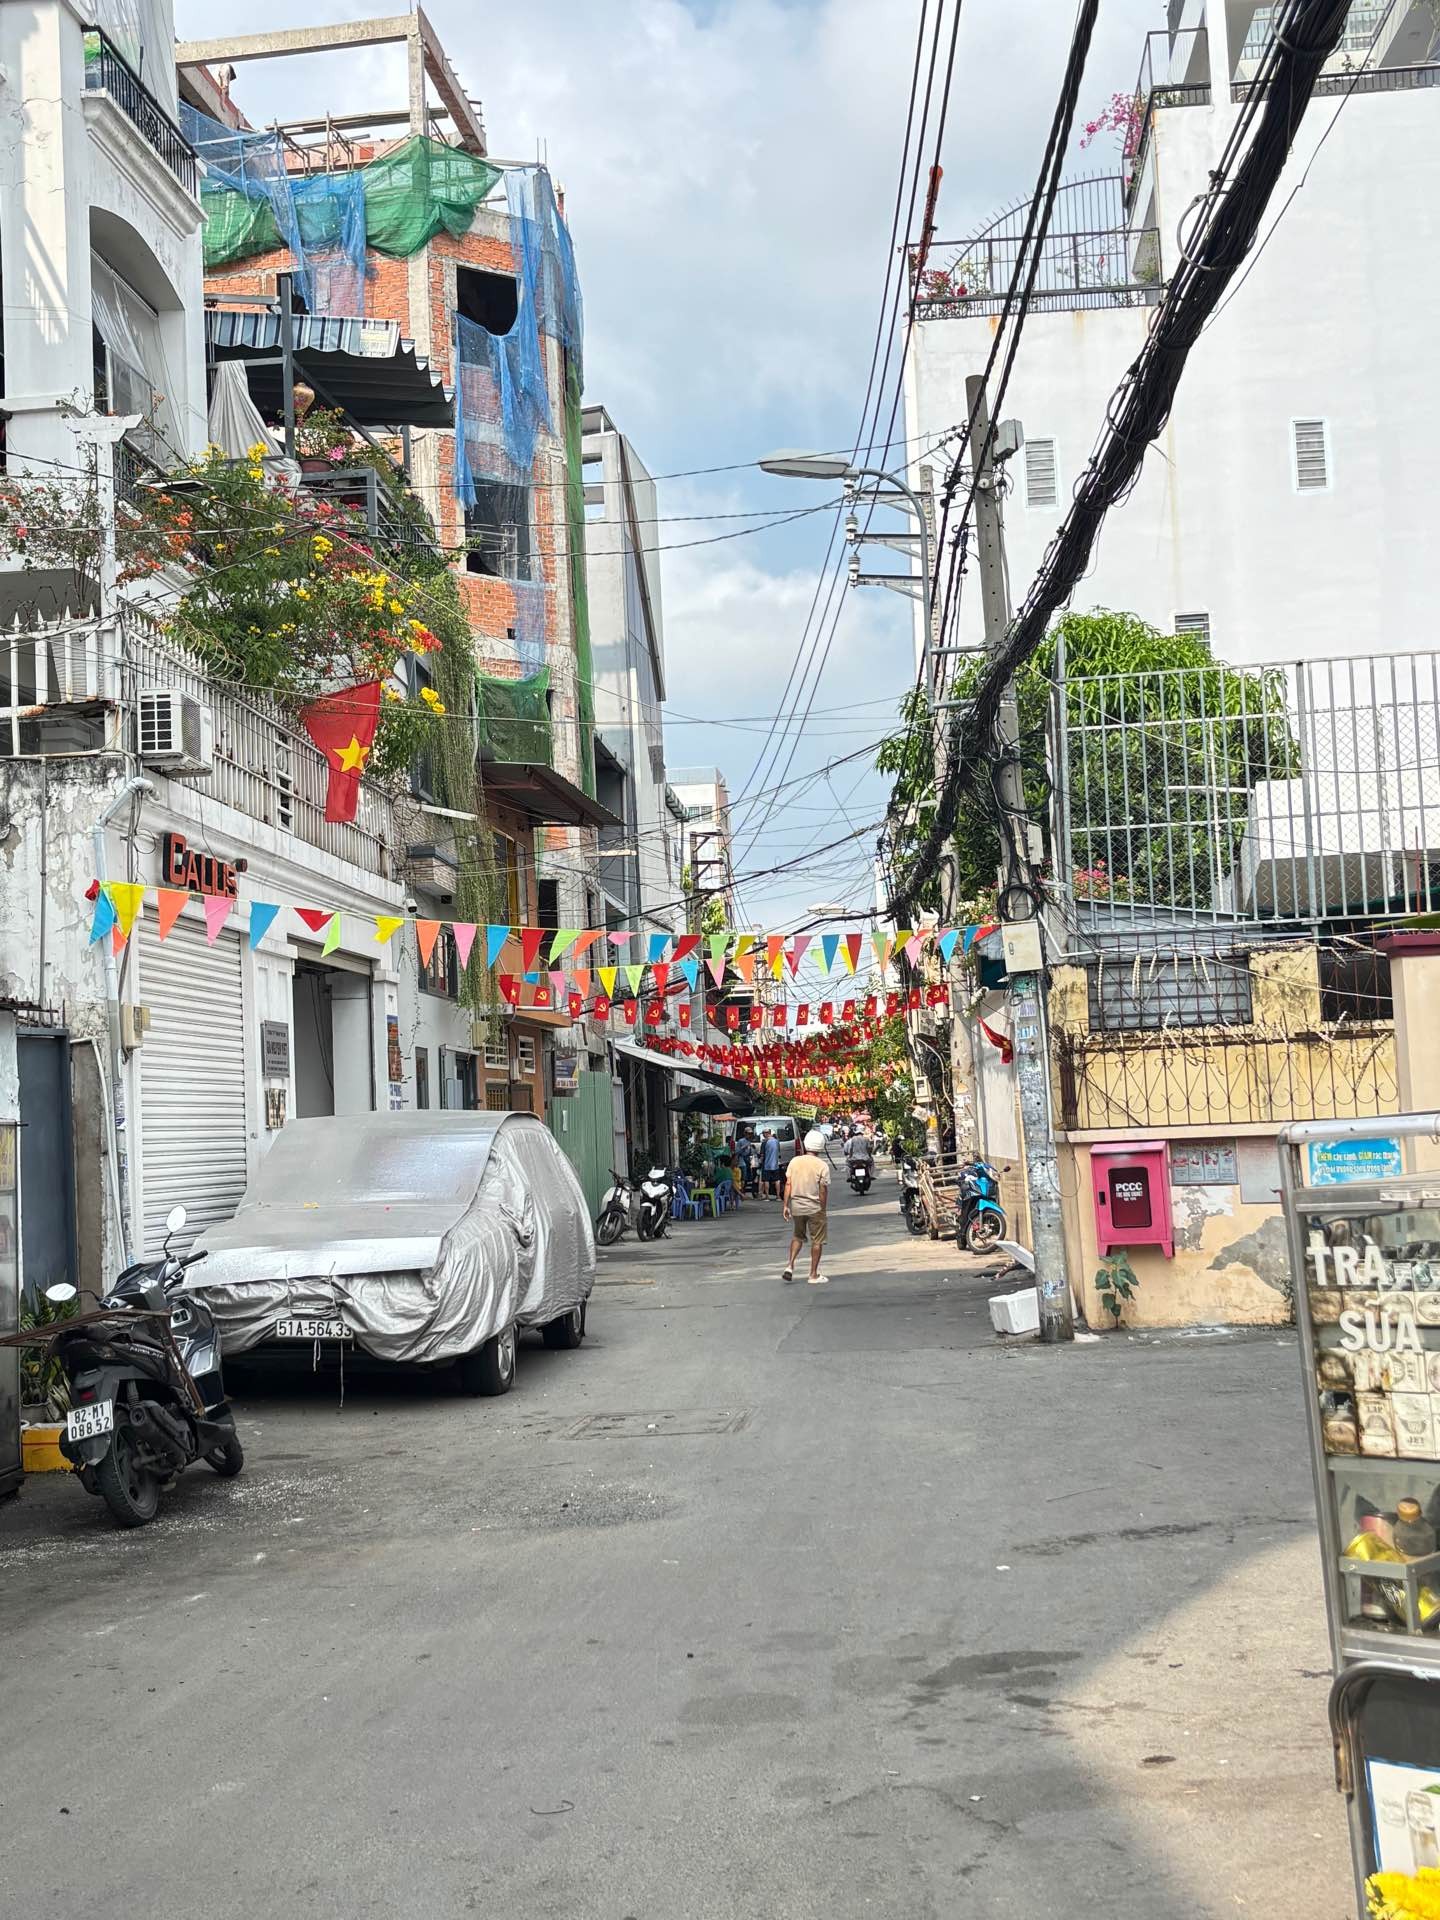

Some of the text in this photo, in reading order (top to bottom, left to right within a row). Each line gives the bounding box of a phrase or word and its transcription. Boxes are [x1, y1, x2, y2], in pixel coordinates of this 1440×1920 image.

[1116, 1182, 1143, 1192] PCCC
[1307, 1235, 1392, 1286] TRÀ
[279, 1320, 352, 1337] 51A-564.33
[71, 1417, 110, 1439] 088.52
